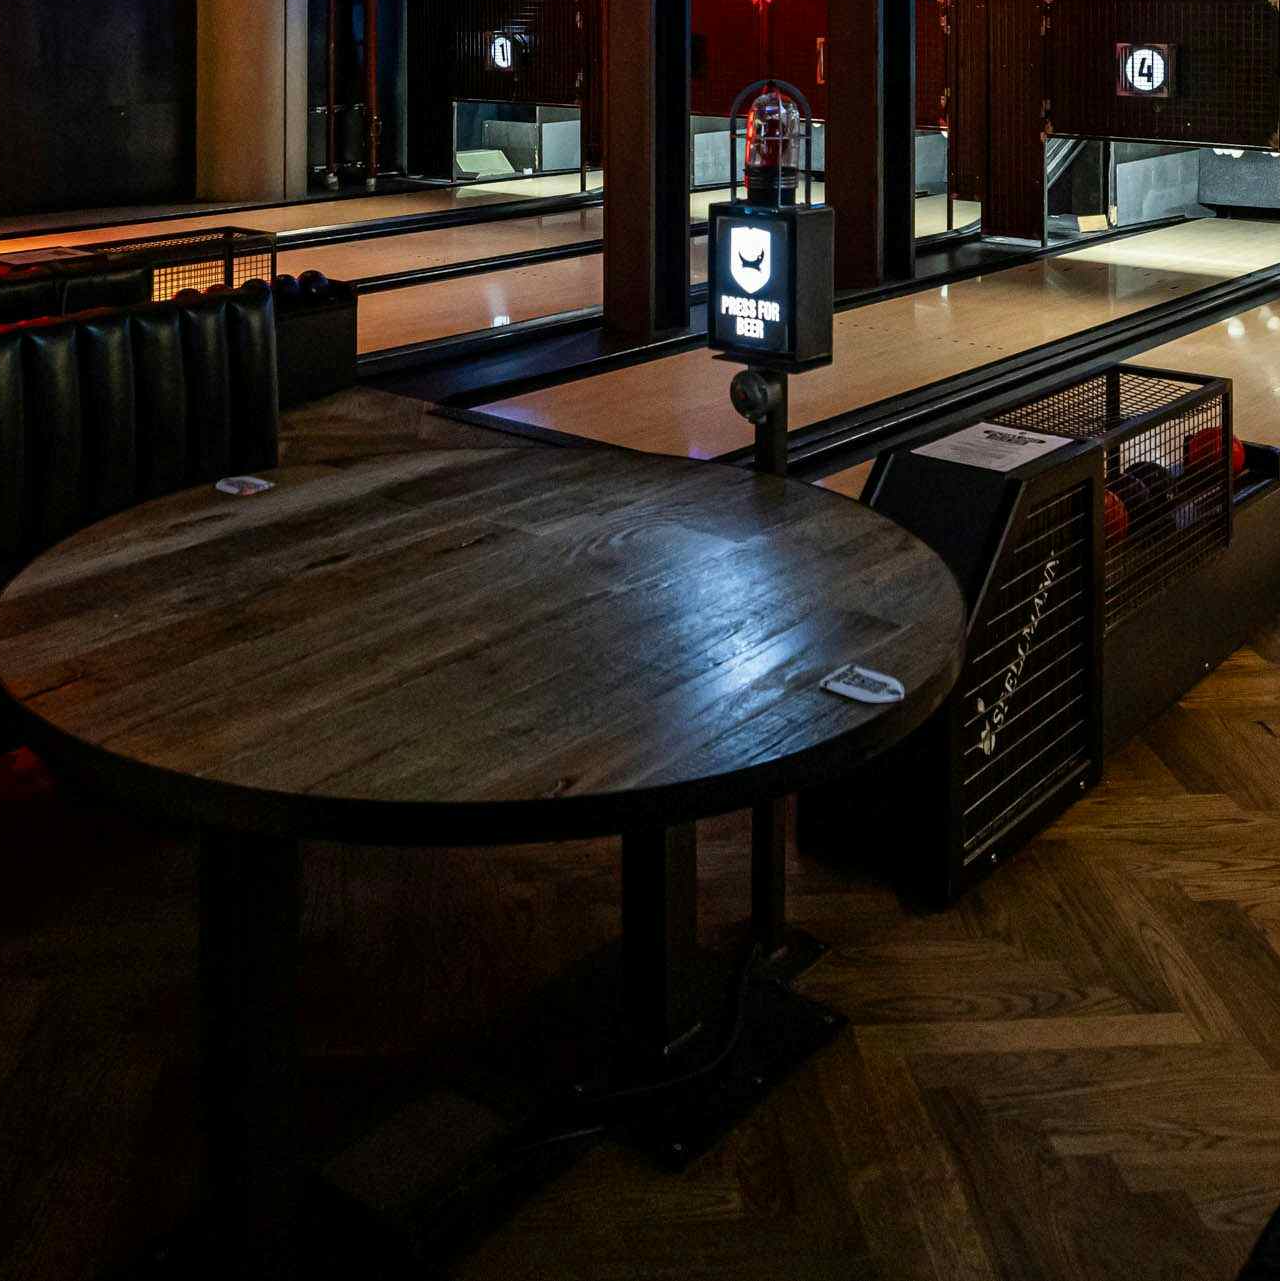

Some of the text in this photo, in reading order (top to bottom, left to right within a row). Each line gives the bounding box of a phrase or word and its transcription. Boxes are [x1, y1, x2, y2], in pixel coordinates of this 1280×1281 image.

[1138, 57, 1153, 83] 4
[721, 295, 780, 322] PRESS FOR
[736, 317, 765, 339] BEER
